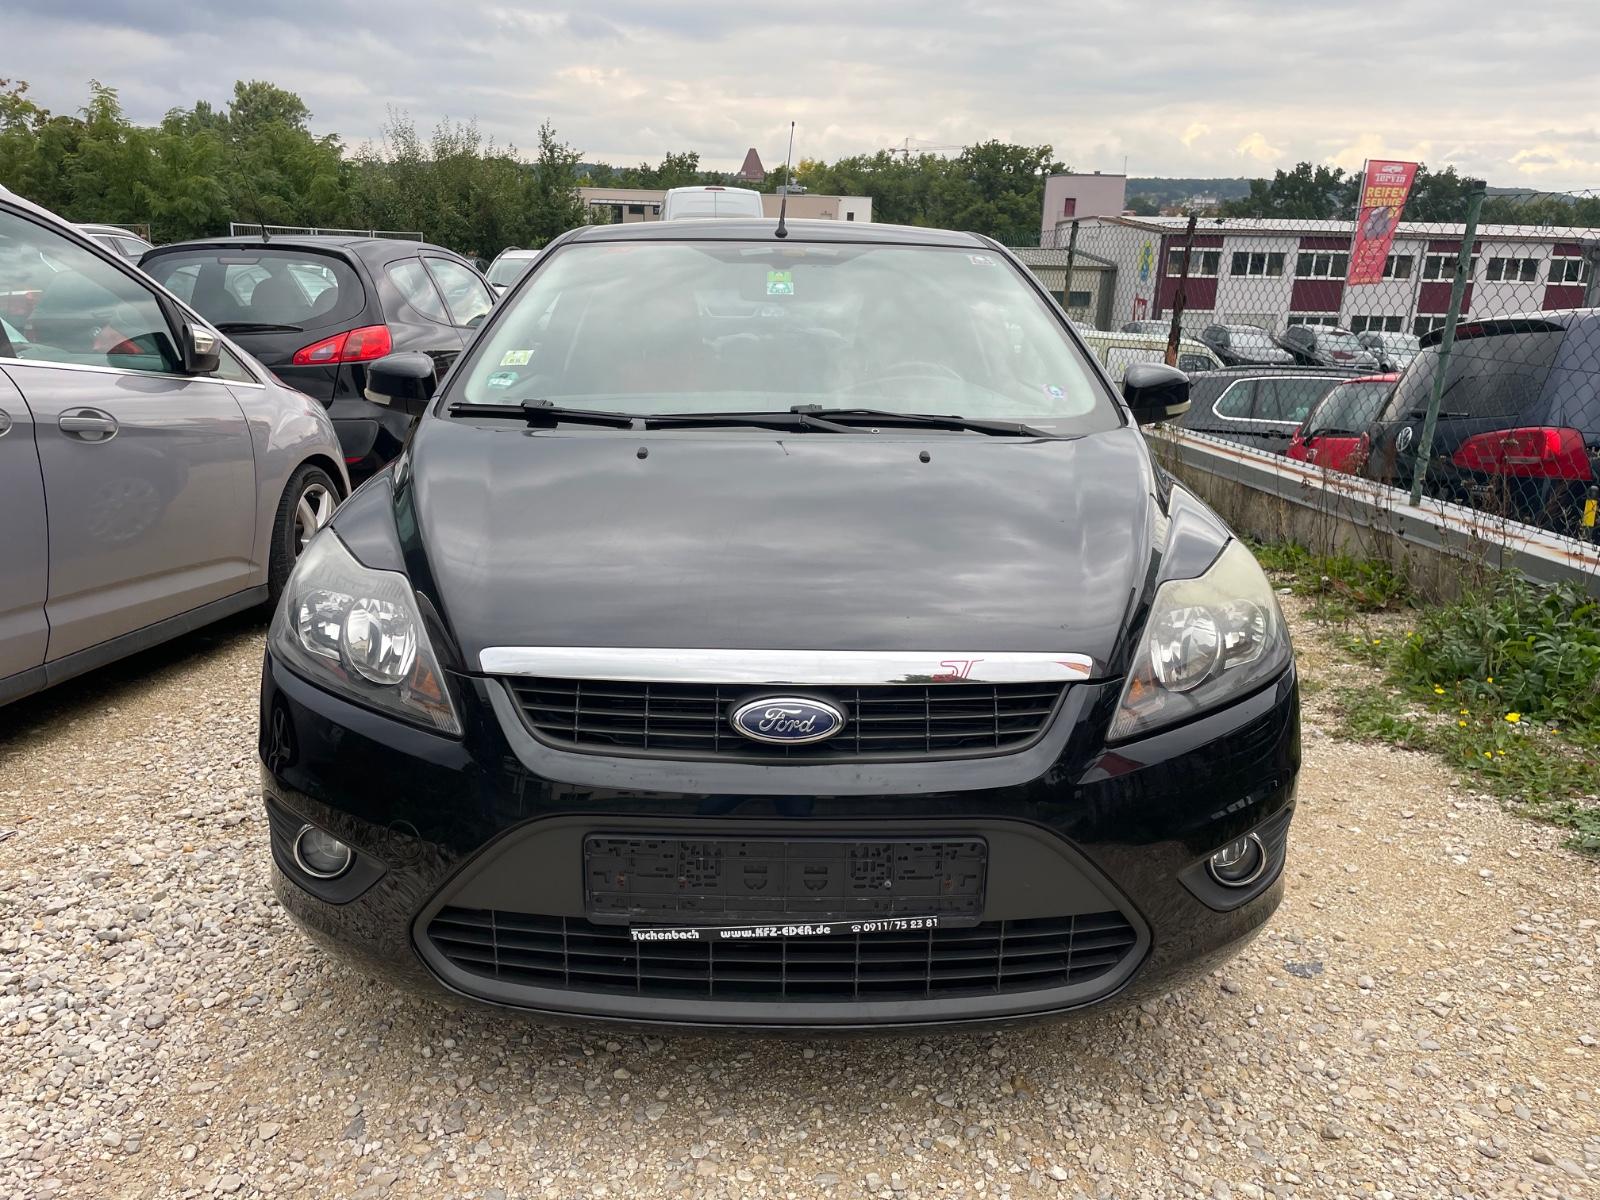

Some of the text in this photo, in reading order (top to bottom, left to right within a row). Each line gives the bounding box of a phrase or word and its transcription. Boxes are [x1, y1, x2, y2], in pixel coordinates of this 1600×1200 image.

[1367, 187, 1407, 198] REIFEN
[1364, 198, 1402, 207] SERVICE
[758, 708, 816, 732] Ford
[631, 930, 700, 940] Tuchenbach
[863, 920, 907, 932] 0911/75
[910, 919, 923, 929] 23
[925, 918, 938, 927] 81
